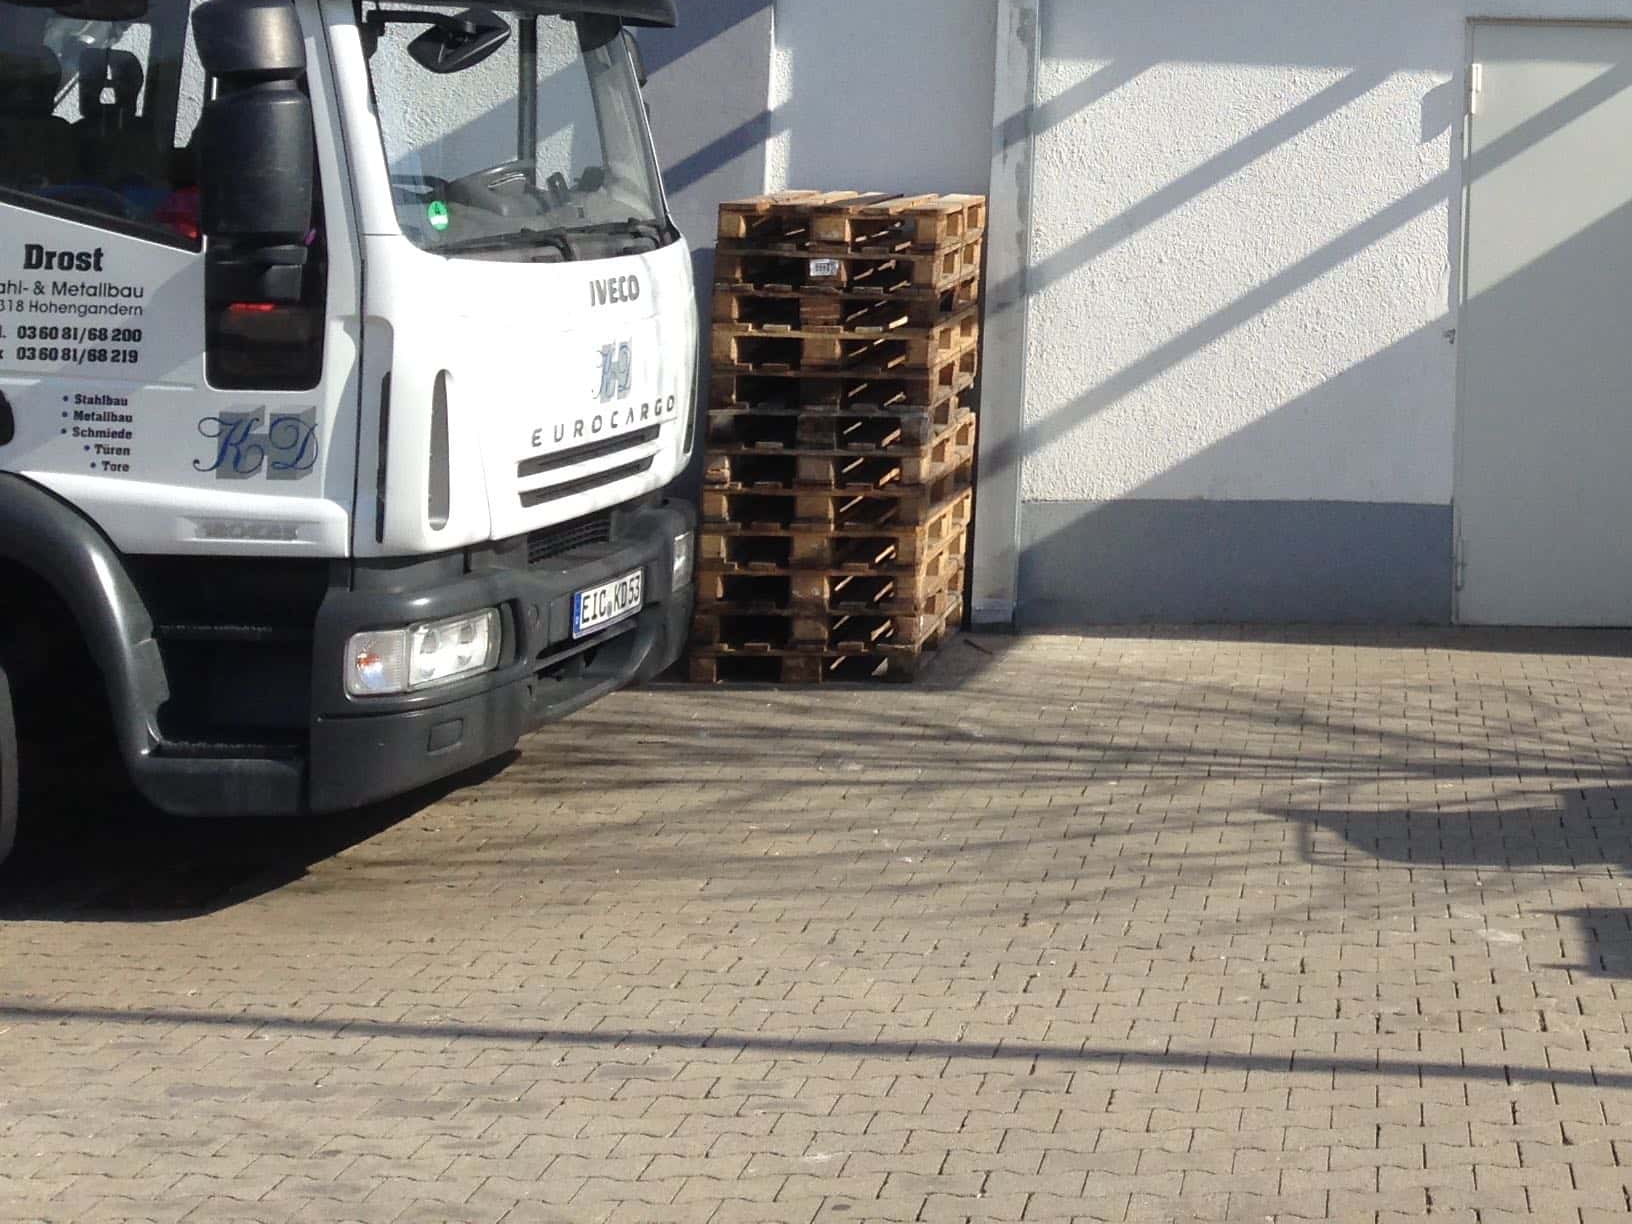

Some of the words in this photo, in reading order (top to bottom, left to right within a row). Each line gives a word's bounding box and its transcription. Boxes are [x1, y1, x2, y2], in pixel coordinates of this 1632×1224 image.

[24, 243, 104, 272] Drost
[33, 280, 45, 296] &
[52, 281, 144, 298] Metallbau
[590, 274, 640, 307] IVECO
[29, 300, 143, 317] Hohengandern
[74, 393, 129, 407] Stahlbau
[73, 410, 133, 423] Metallbau
[531, 394, 675, 448] EUROCARGO
[72, 426, 132, 439] Schmiede
[94, 443, 131, 456] Türen
[101, 460, 130, 472] Tore
[582, 589, 606, 624] EIC
